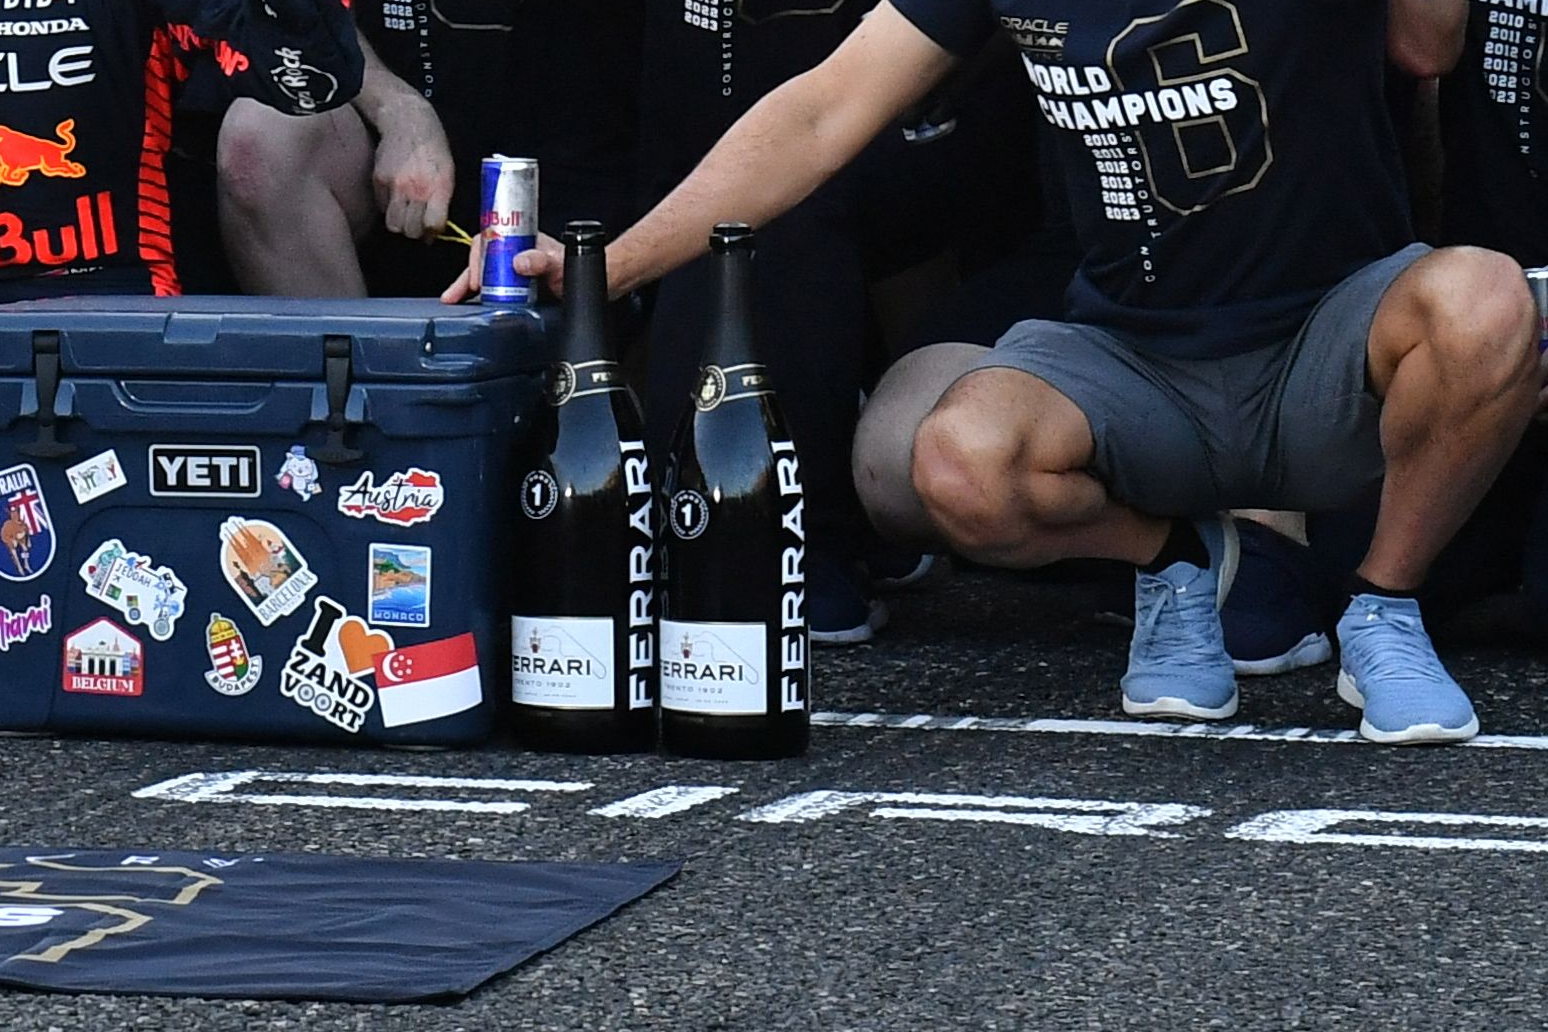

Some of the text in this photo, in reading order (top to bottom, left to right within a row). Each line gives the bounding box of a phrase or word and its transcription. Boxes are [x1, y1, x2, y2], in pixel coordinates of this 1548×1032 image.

[383, 2, 414, 17] 2022
[684, 0, 719, 18] 2022
[384, 16, 416, 31] 2023
[684, 11, 718, 32] 2023
[1000, 16, 1070, 34] ORACLE
[1489, 10, 1524, 28] 2010
[1489, 27, 1521, 44] 2011
[1484, 41, 1519, 59] 2012
[1021, 52, 1112, 96] WORLD
[1483, 57, 1518, 74] 2013
[1485, 73, 1518, 89] 022
[1037, 78, 1239, 130] CHAMPIONS
[1490, 88, 1517, 104] 23
[1083, 133, 1119, 146] 2010
[1092, 148, 1126, 160] 2011
[1096, 161, 1130, 174] 2012
[1100, 176, 1134, 189] 2013
[1102, 191, 1137, 205] 2022
[1105, 206, 1141, 220] 2023
[1120, 132, 1161, 283] CONTRUCTORS'
[491, 211, 519, 226] Bull
[157, 456, 250, 487] YETI
[343, 474, 439, 512] Austria
[531, 483, 542, 506] 1
[681, 503, 692, 527] 1
[115, 563, 152, 588] JEDDAH
[619, 440, 653, 710] FERRARI
[771, 440, 805, 713] FERRARI
[258, 571, 313, 622] BARCELONA
[373, 611, 425, 623] MONACO
[301, 600, 344, 657] I
[513, 655, 591, 676] ERRARI
[663, 660, 743, 681] ERRARI
[71, 676, 135, 693] BELGIUM
[212, 661, 260, 693] BUDAPEST
[290, 650, 370, 709] ZAND
